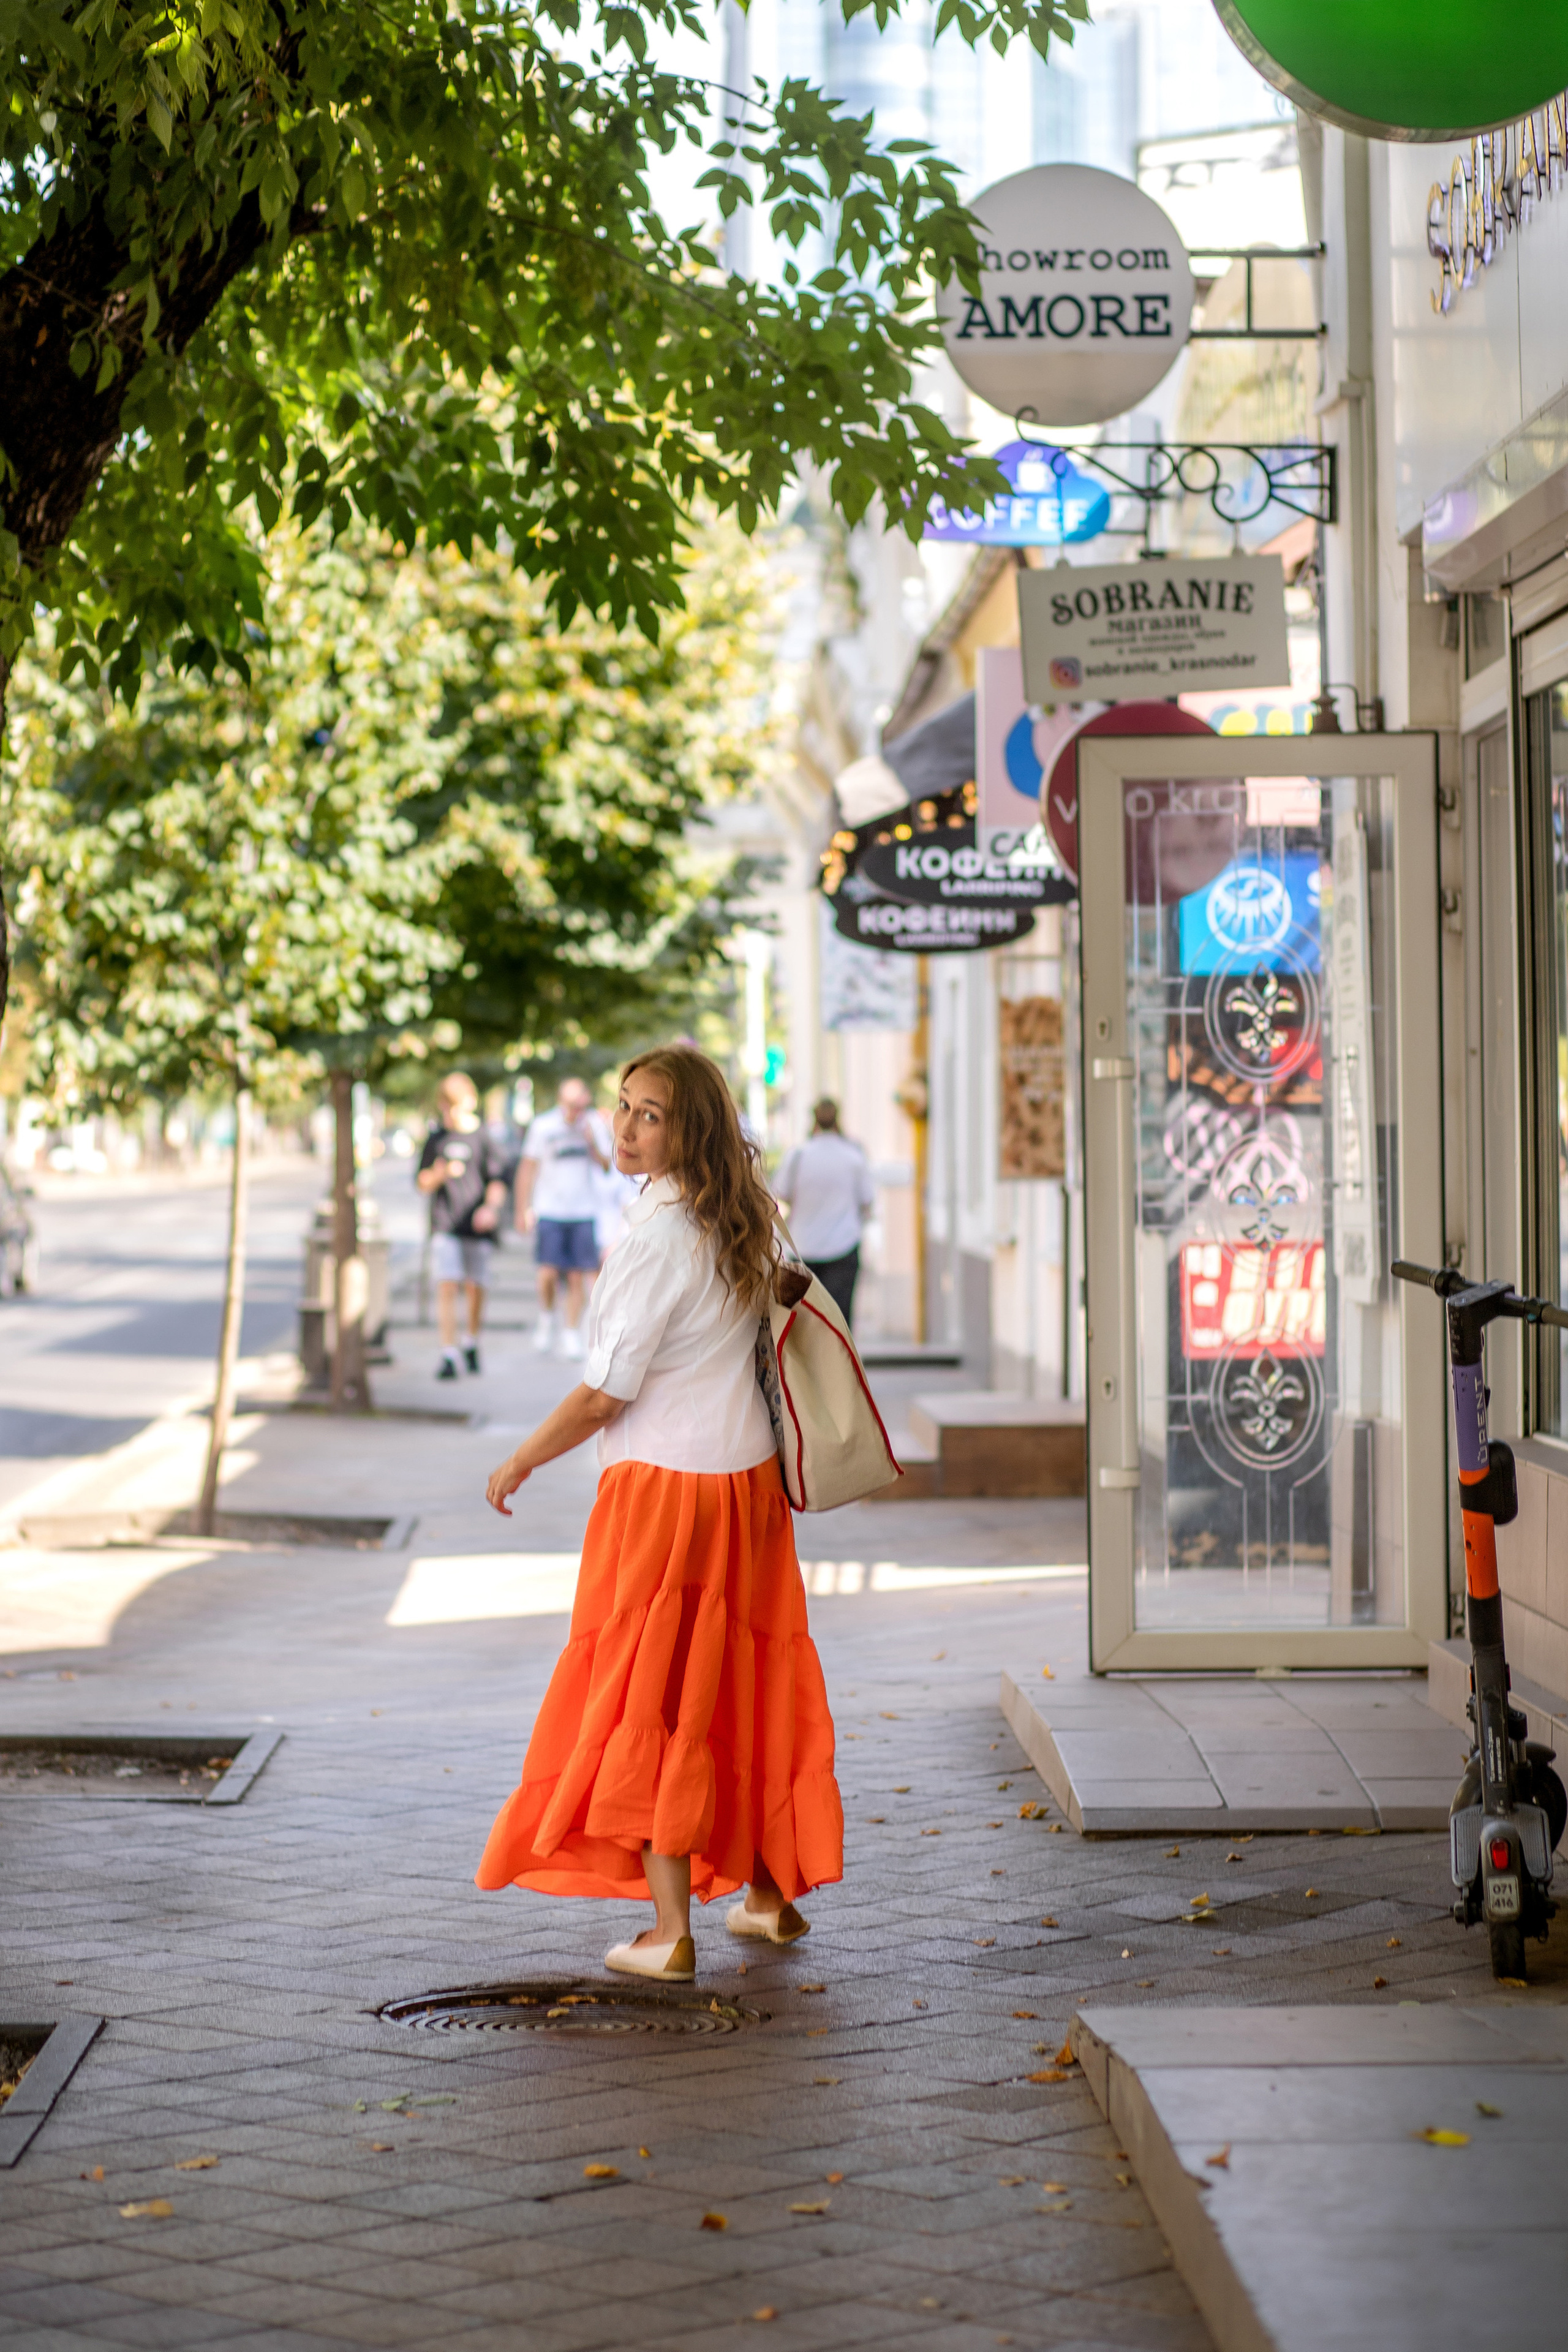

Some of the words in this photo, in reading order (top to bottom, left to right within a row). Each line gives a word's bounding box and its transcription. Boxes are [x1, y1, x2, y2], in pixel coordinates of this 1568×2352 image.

[981, 243, 1170, 271] howroom
[956, 295, 1171, 339] AMORE
[1050, 578, 1254, 626] SOBRANIE
